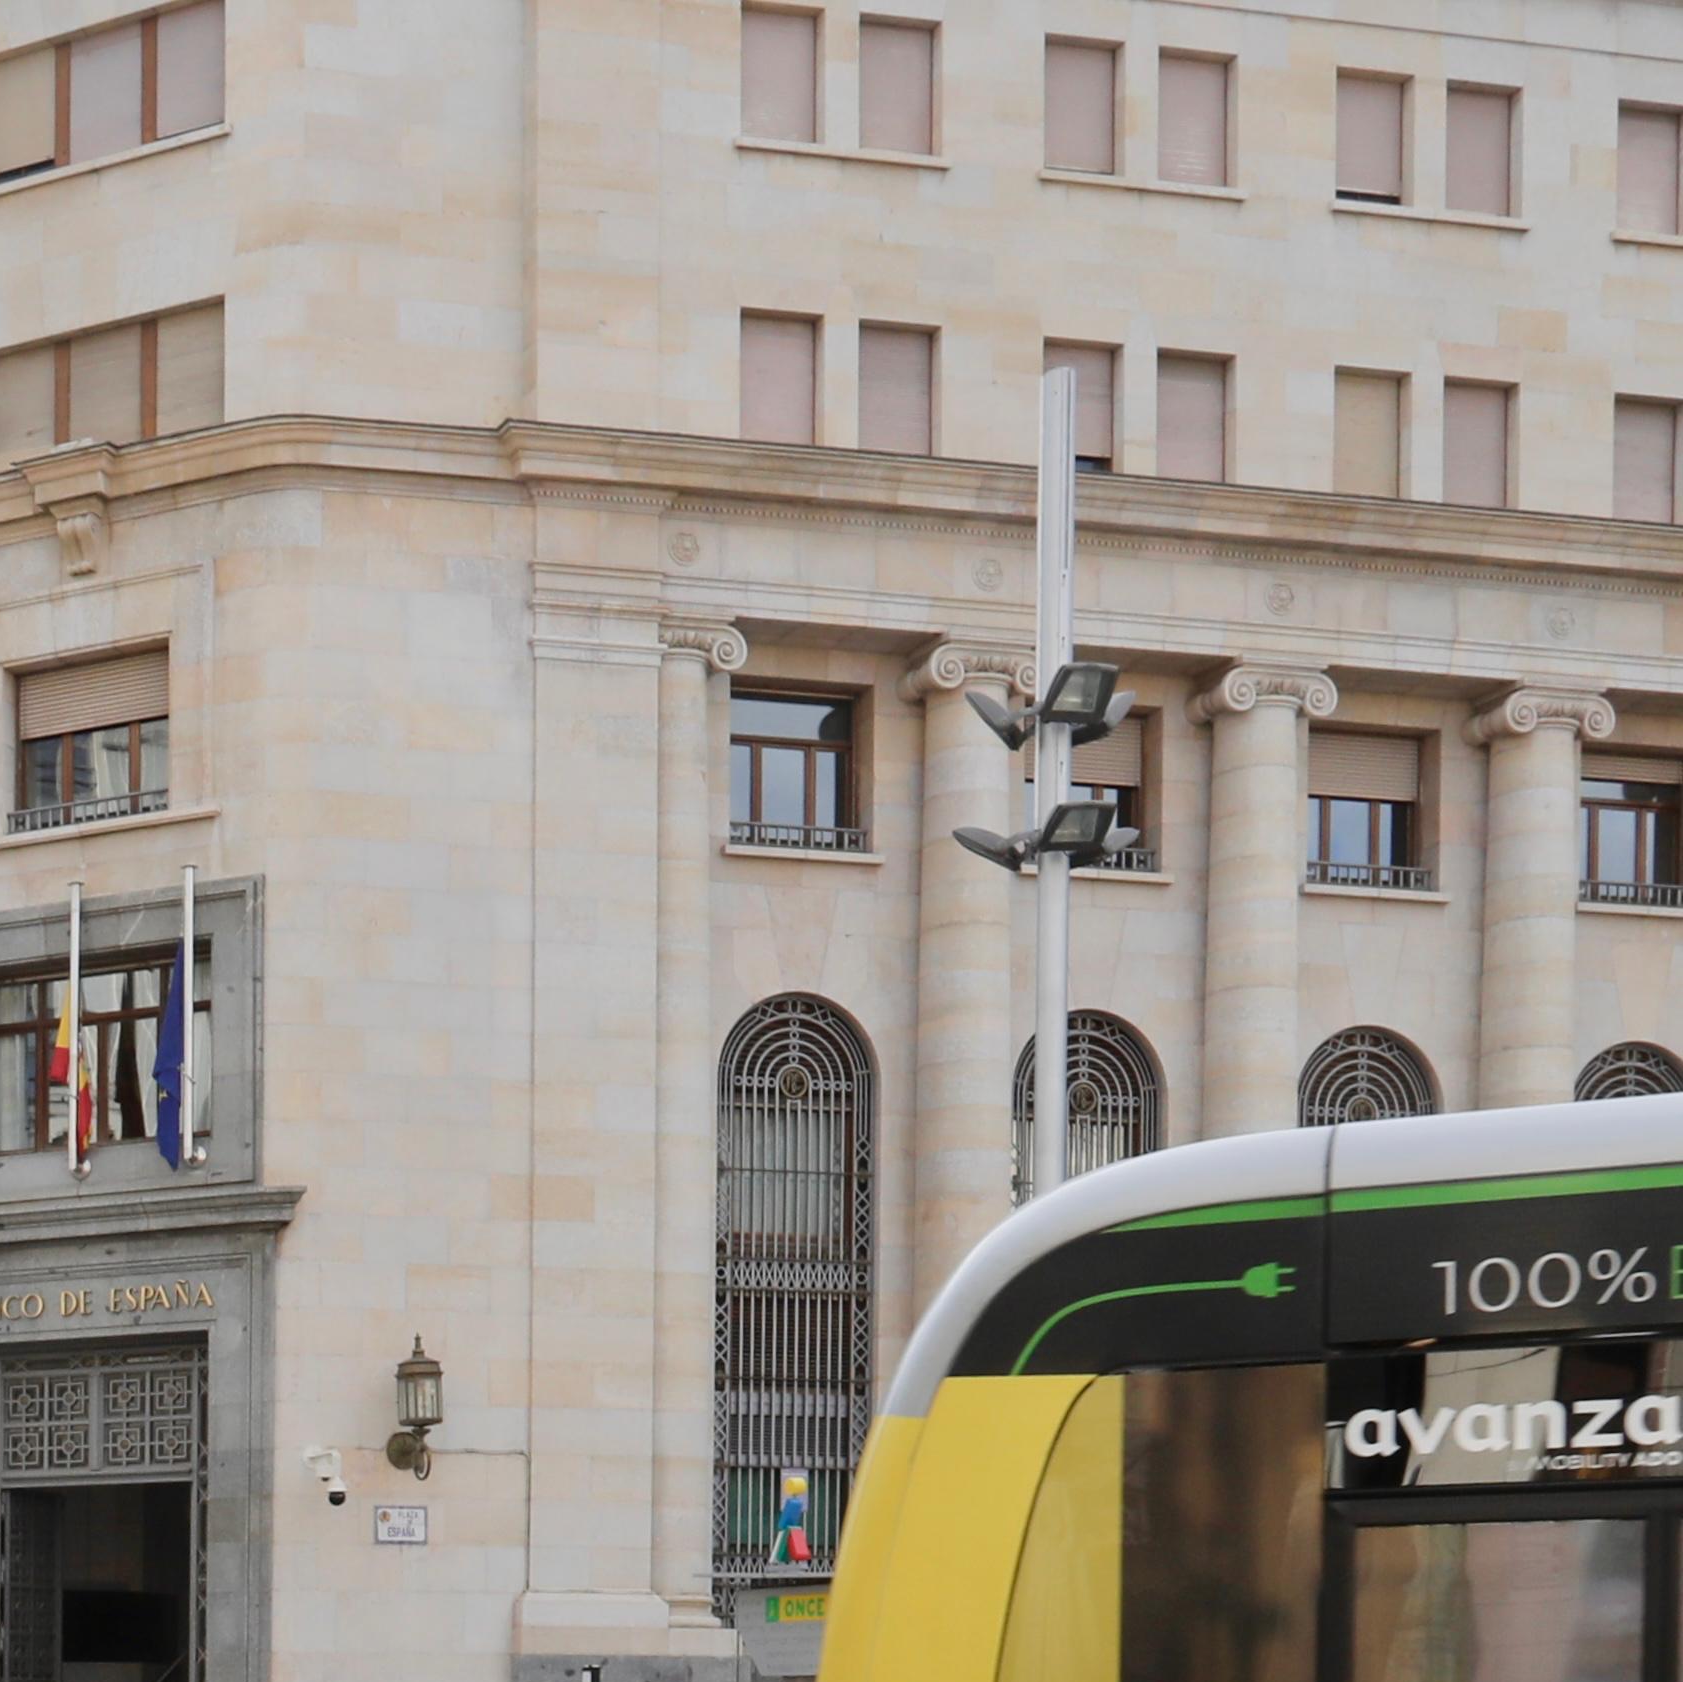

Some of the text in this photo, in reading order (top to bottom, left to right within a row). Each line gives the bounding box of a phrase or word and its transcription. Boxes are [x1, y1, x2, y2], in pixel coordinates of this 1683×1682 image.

[60, 1289, 93, 1317] DE
[108, 1279, 215, 1313] ESPAÑA
[1431, 1247, 1657, 1316] 100%
[1345, 1394, 1683, 1458] avanza
[785, 1597, 826, 1617] ONCE
